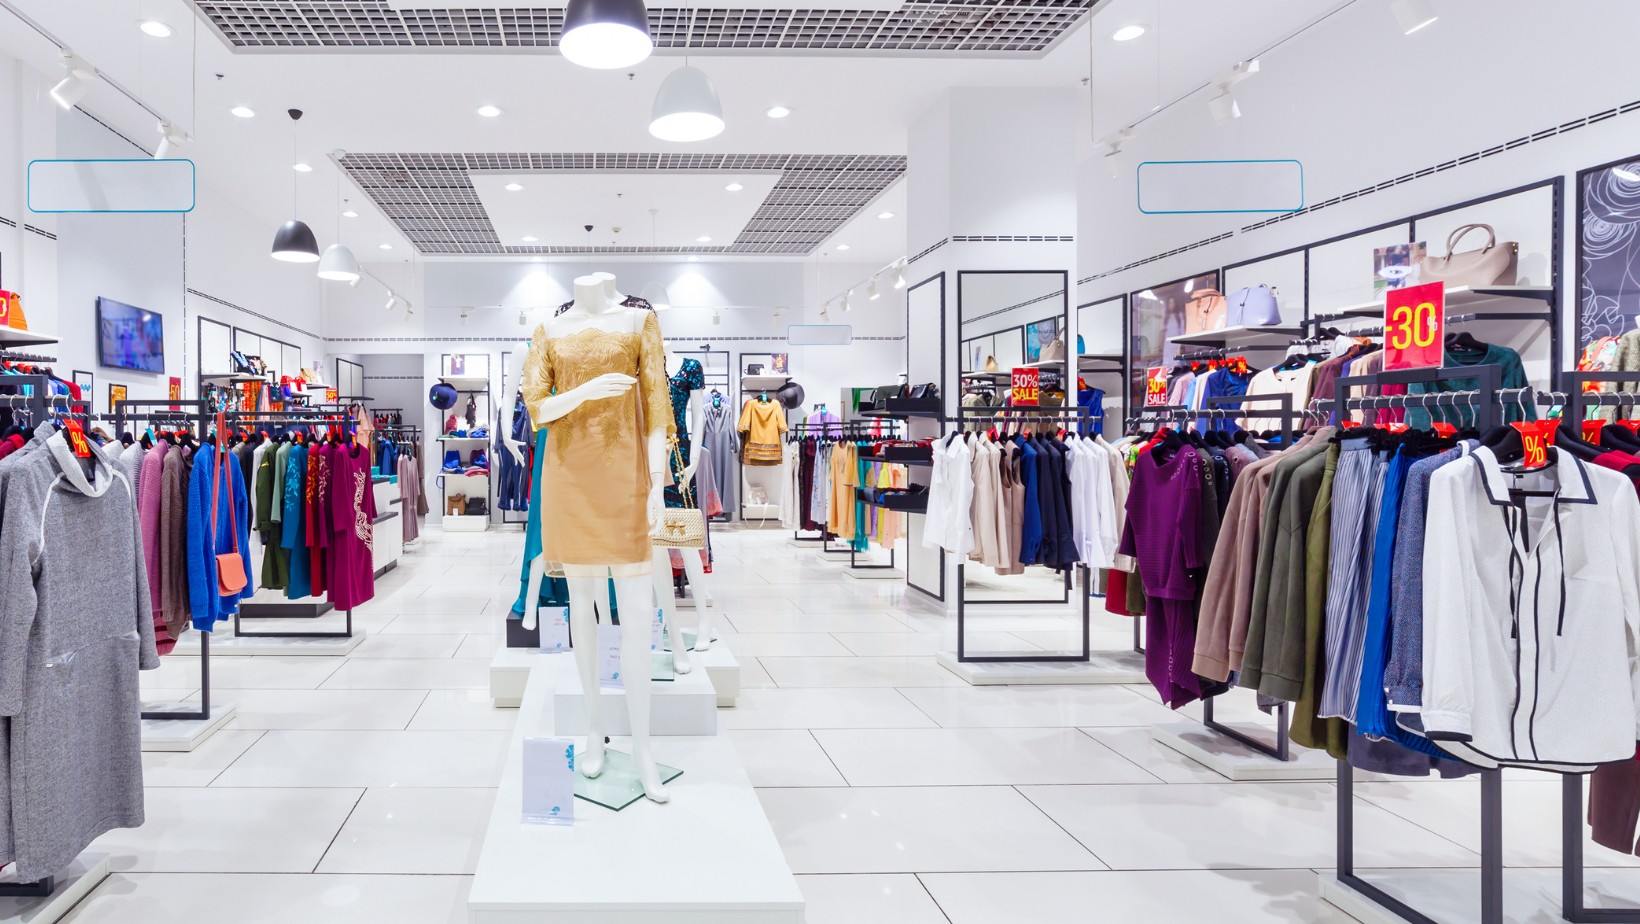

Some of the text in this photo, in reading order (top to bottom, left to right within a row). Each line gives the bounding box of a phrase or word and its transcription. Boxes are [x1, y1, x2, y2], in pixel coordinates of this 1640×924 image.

[1013, 374, 1038, 388] 30%
[1012, 388, 1038, 400] SALE
[1148, 393, 1166, 405] SALE
[71, 431, 88, 454] %
[1525, 435, 1544, 463] %
